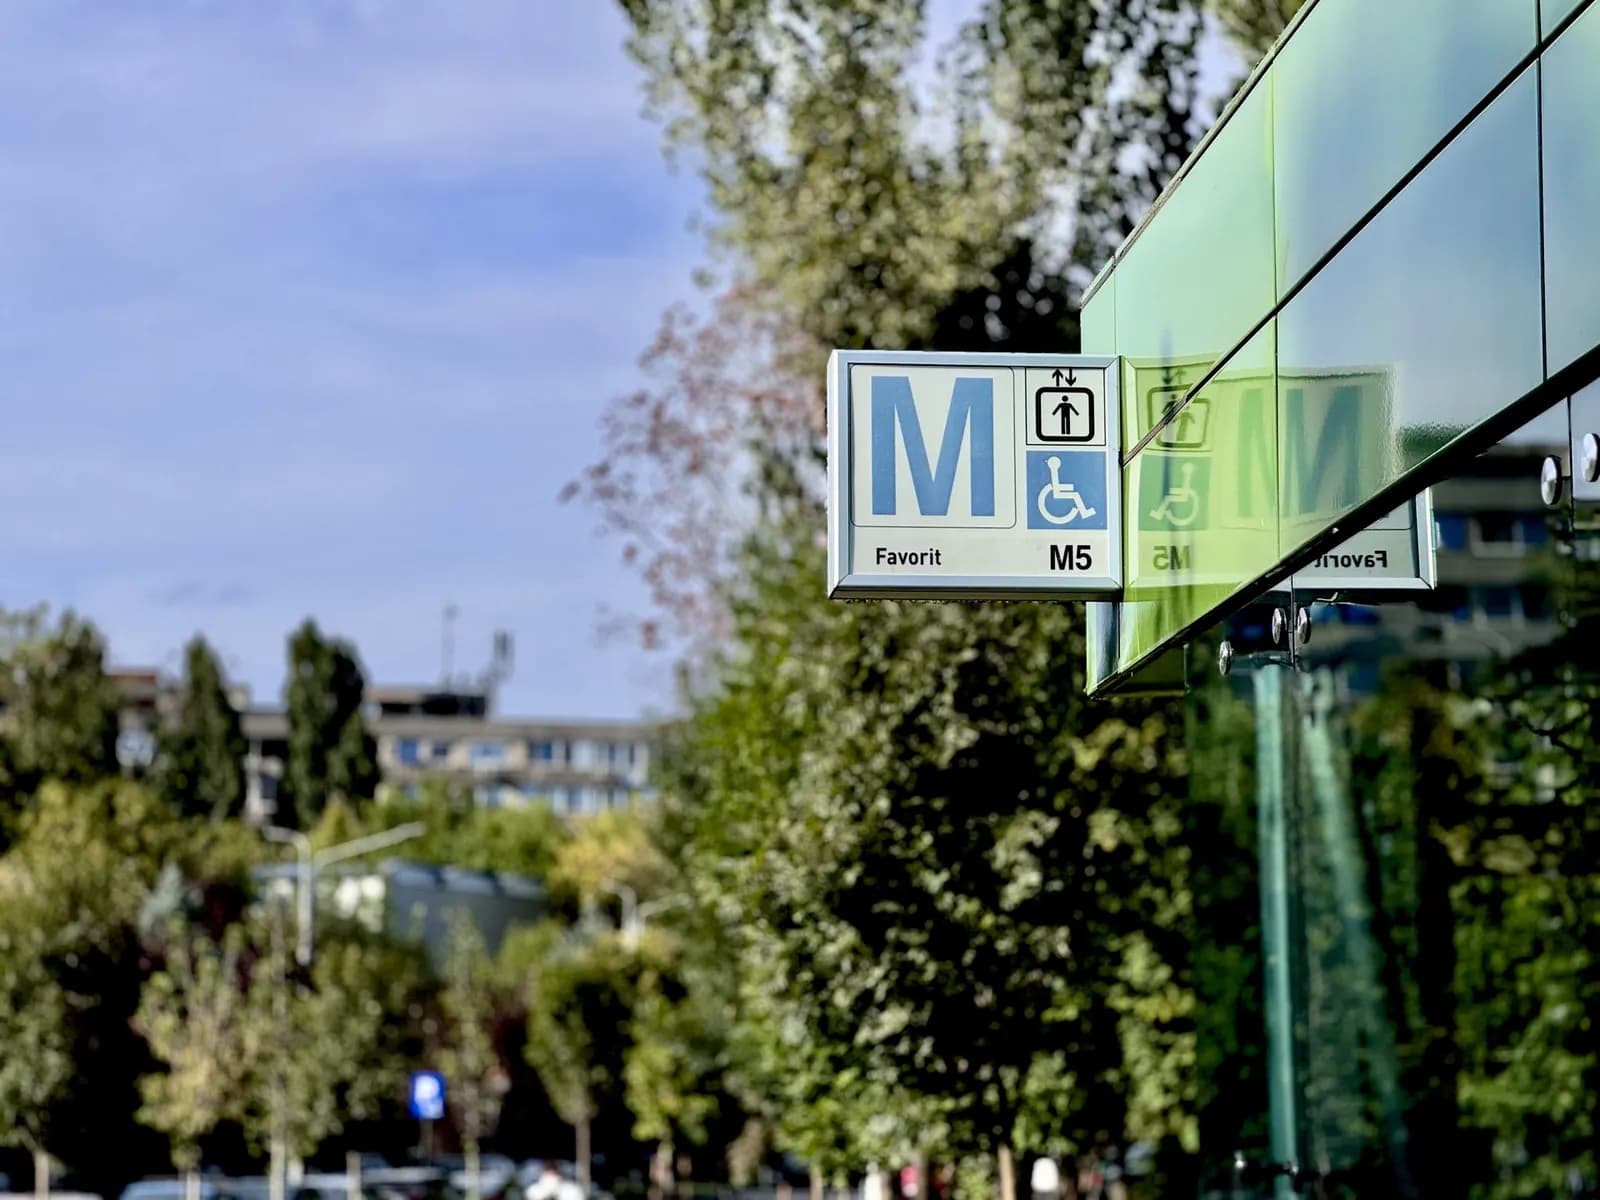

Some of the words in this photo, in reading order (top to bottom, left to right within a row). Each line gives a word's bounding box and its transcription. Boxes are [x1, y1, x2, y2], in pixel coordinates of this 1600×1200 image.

[871, 376, 995, 517] M
[876, 548, 942, 566] Favorit
[1050, 544, 1093, 571] M5
